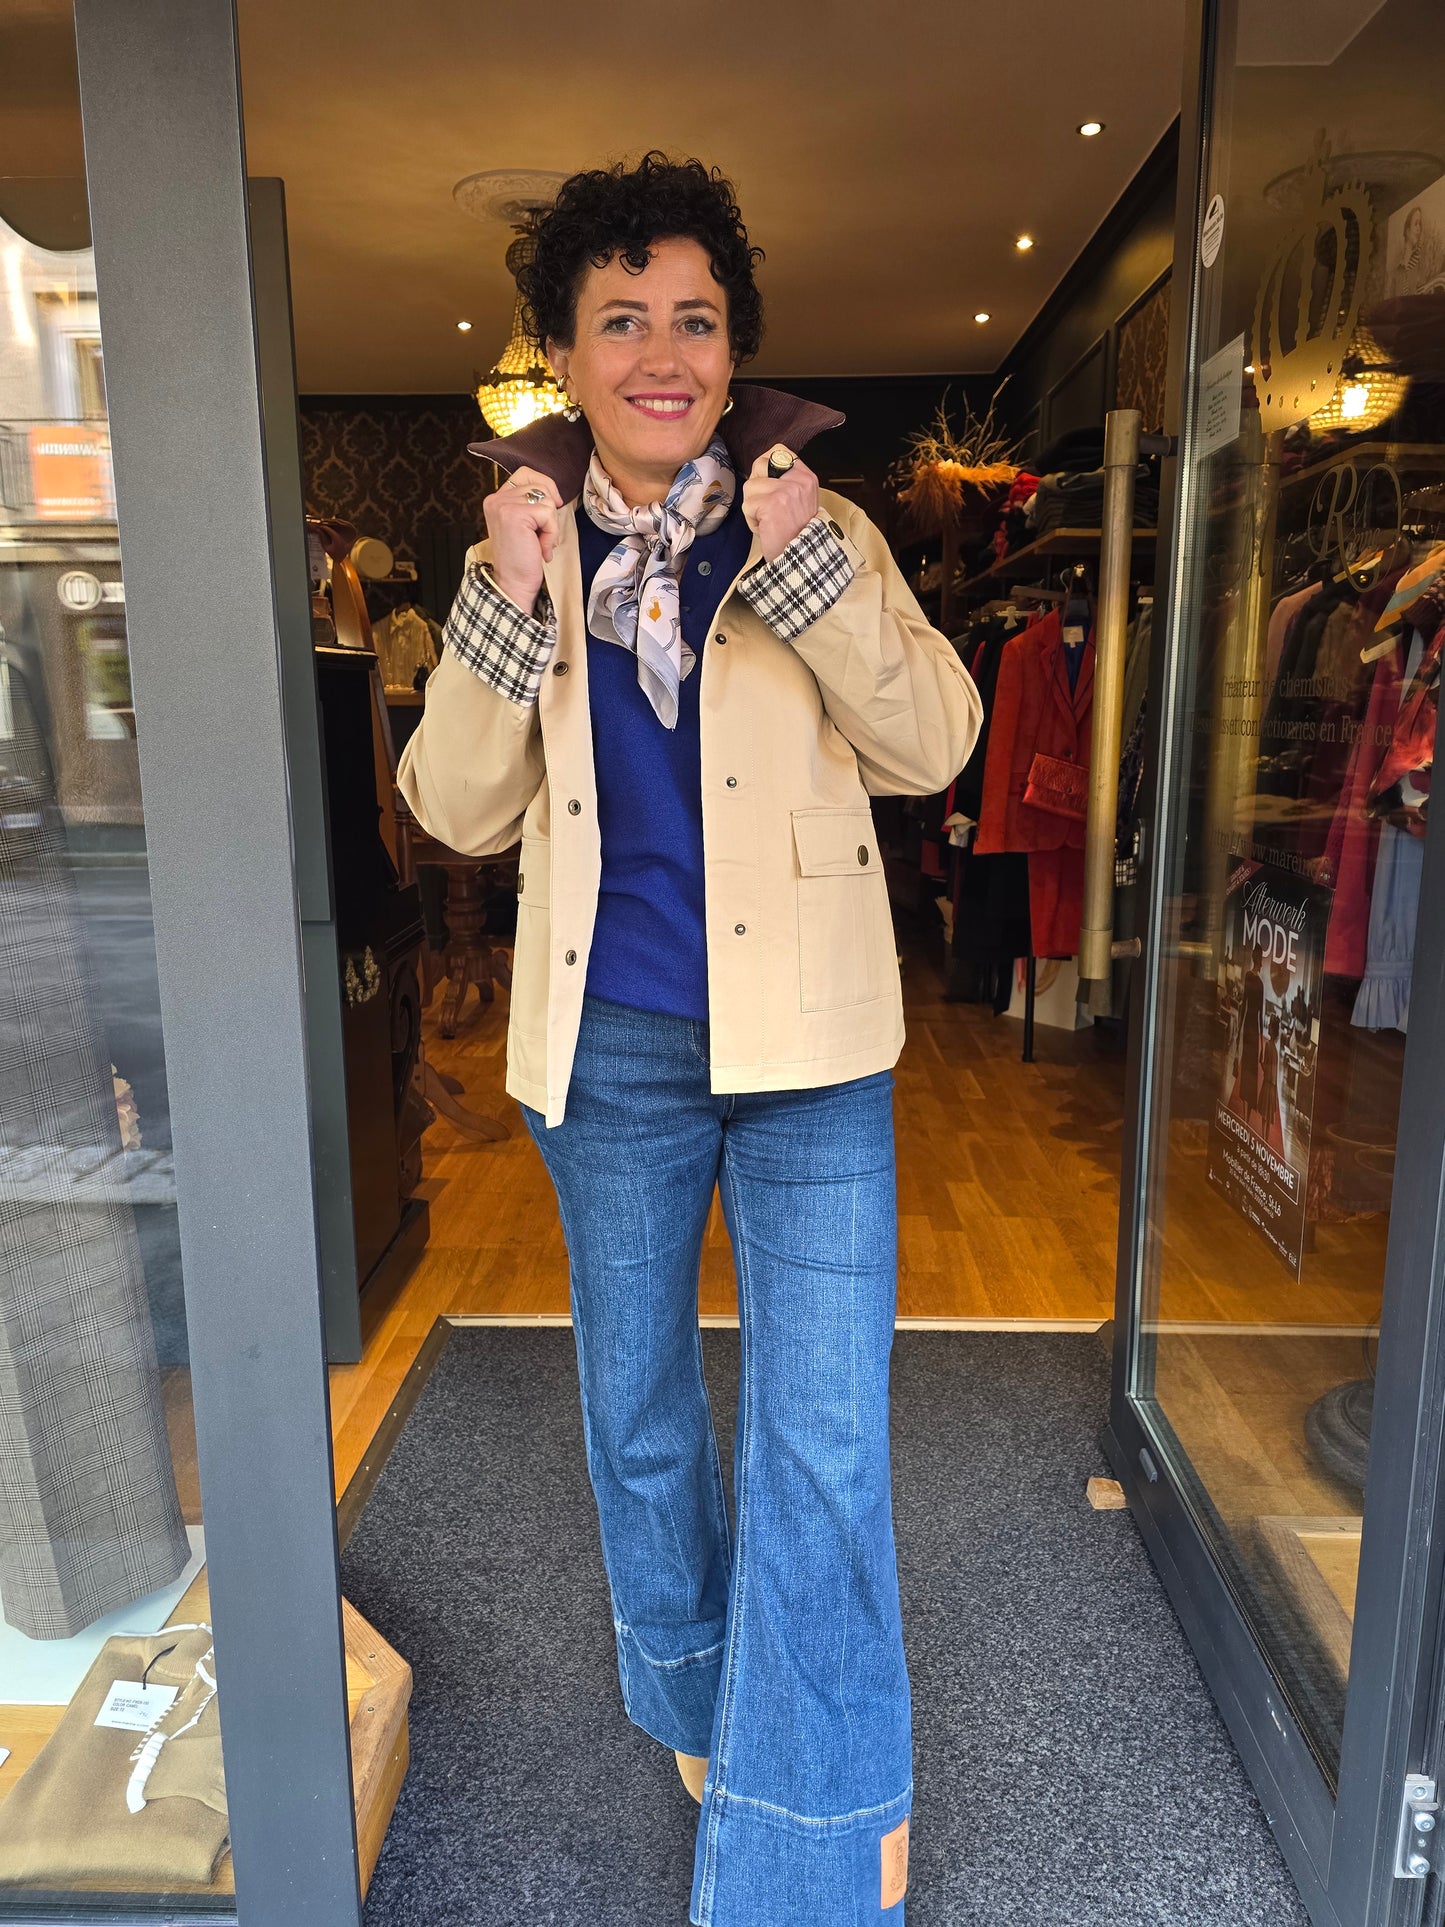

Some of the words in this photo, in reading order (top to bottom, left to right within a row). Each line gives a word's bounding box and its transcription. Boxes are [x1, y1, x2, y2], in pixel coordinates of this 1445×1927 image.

[1320, 722, 1336, 743] en
[1241, 880, 1309, 932] Afterwork
[1243, 909, 1299, 973] MODE
[1217, 1108, 1250, 1146] MERCREDI
[1250, 1136, 1255, 1151] 5
[1255, 1140, 1295, 1190] NOVEMBRE
[1222, 1148, 1244, 1176] Mobilier
[1243, 1169, 1251, 1184] de
